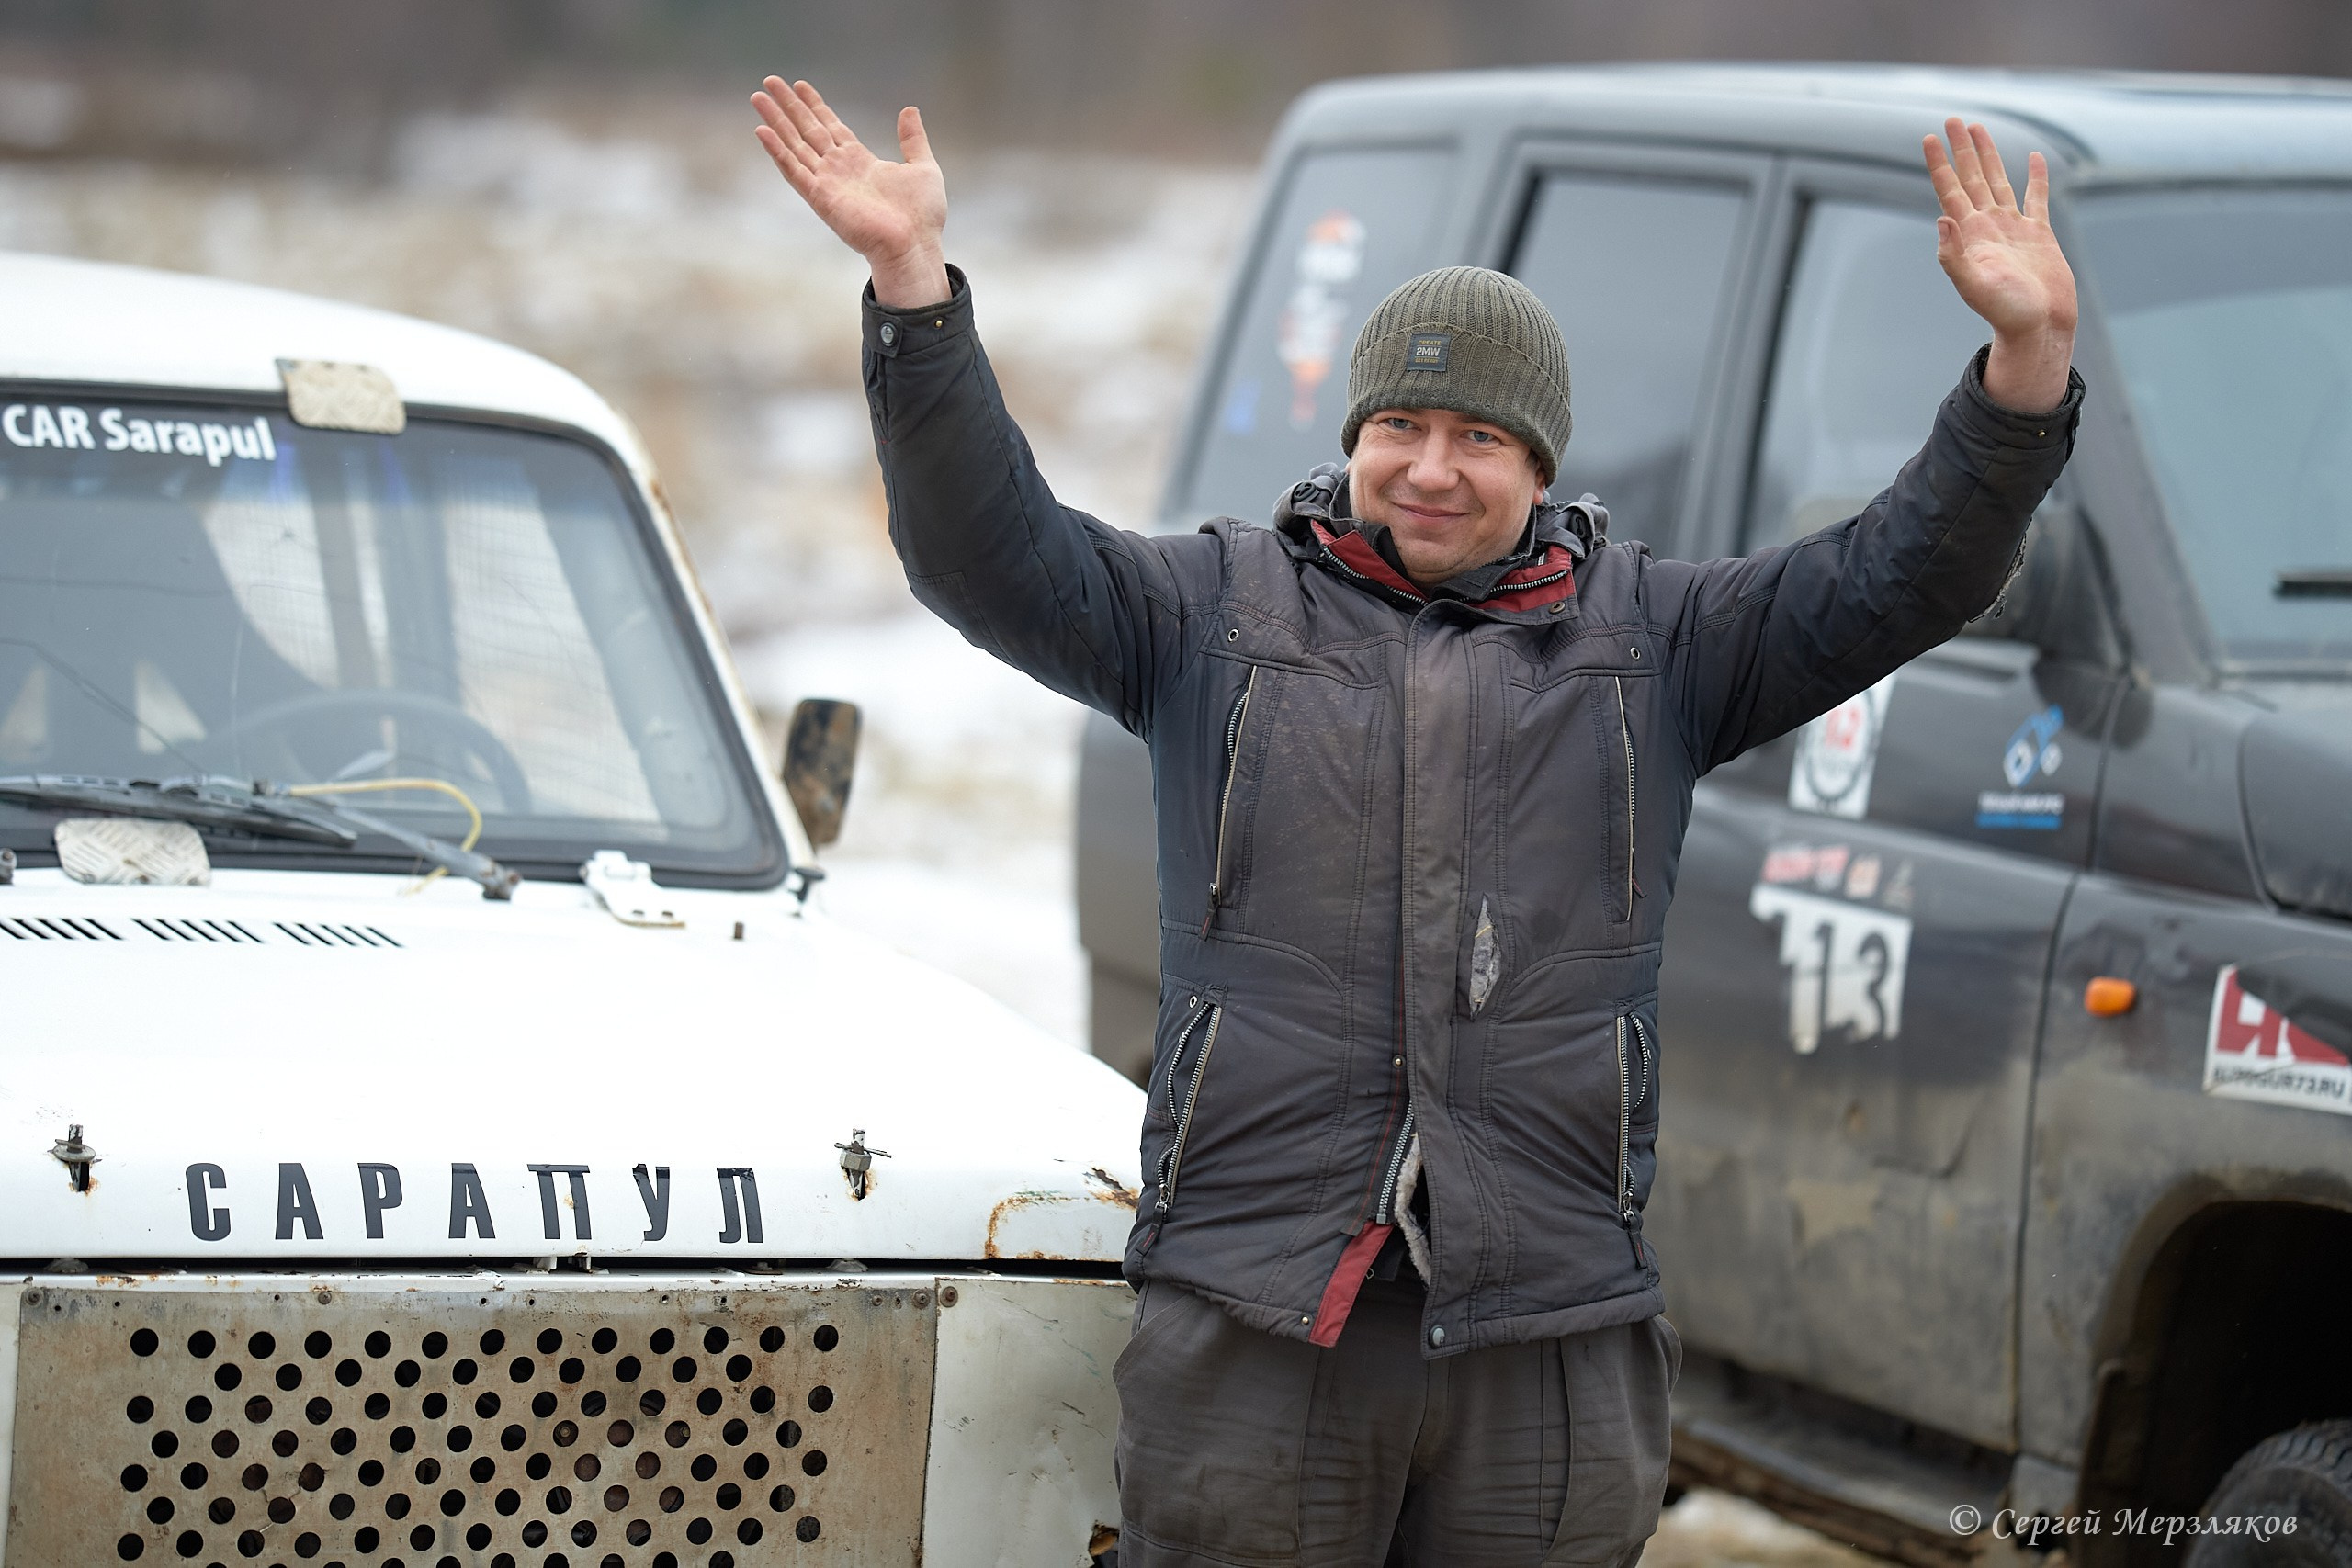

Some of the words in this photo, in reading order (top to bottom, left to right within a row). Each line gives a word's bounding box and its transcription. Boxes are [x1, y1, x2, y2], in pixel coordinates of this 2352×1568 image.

[1416, 346, 1441, 356] 2MW
[2, 404, 96, 450] CAR
[99, 408, 277, 467] Sarapul
[185, 1162, 764, 1244] САРАПУЛ
